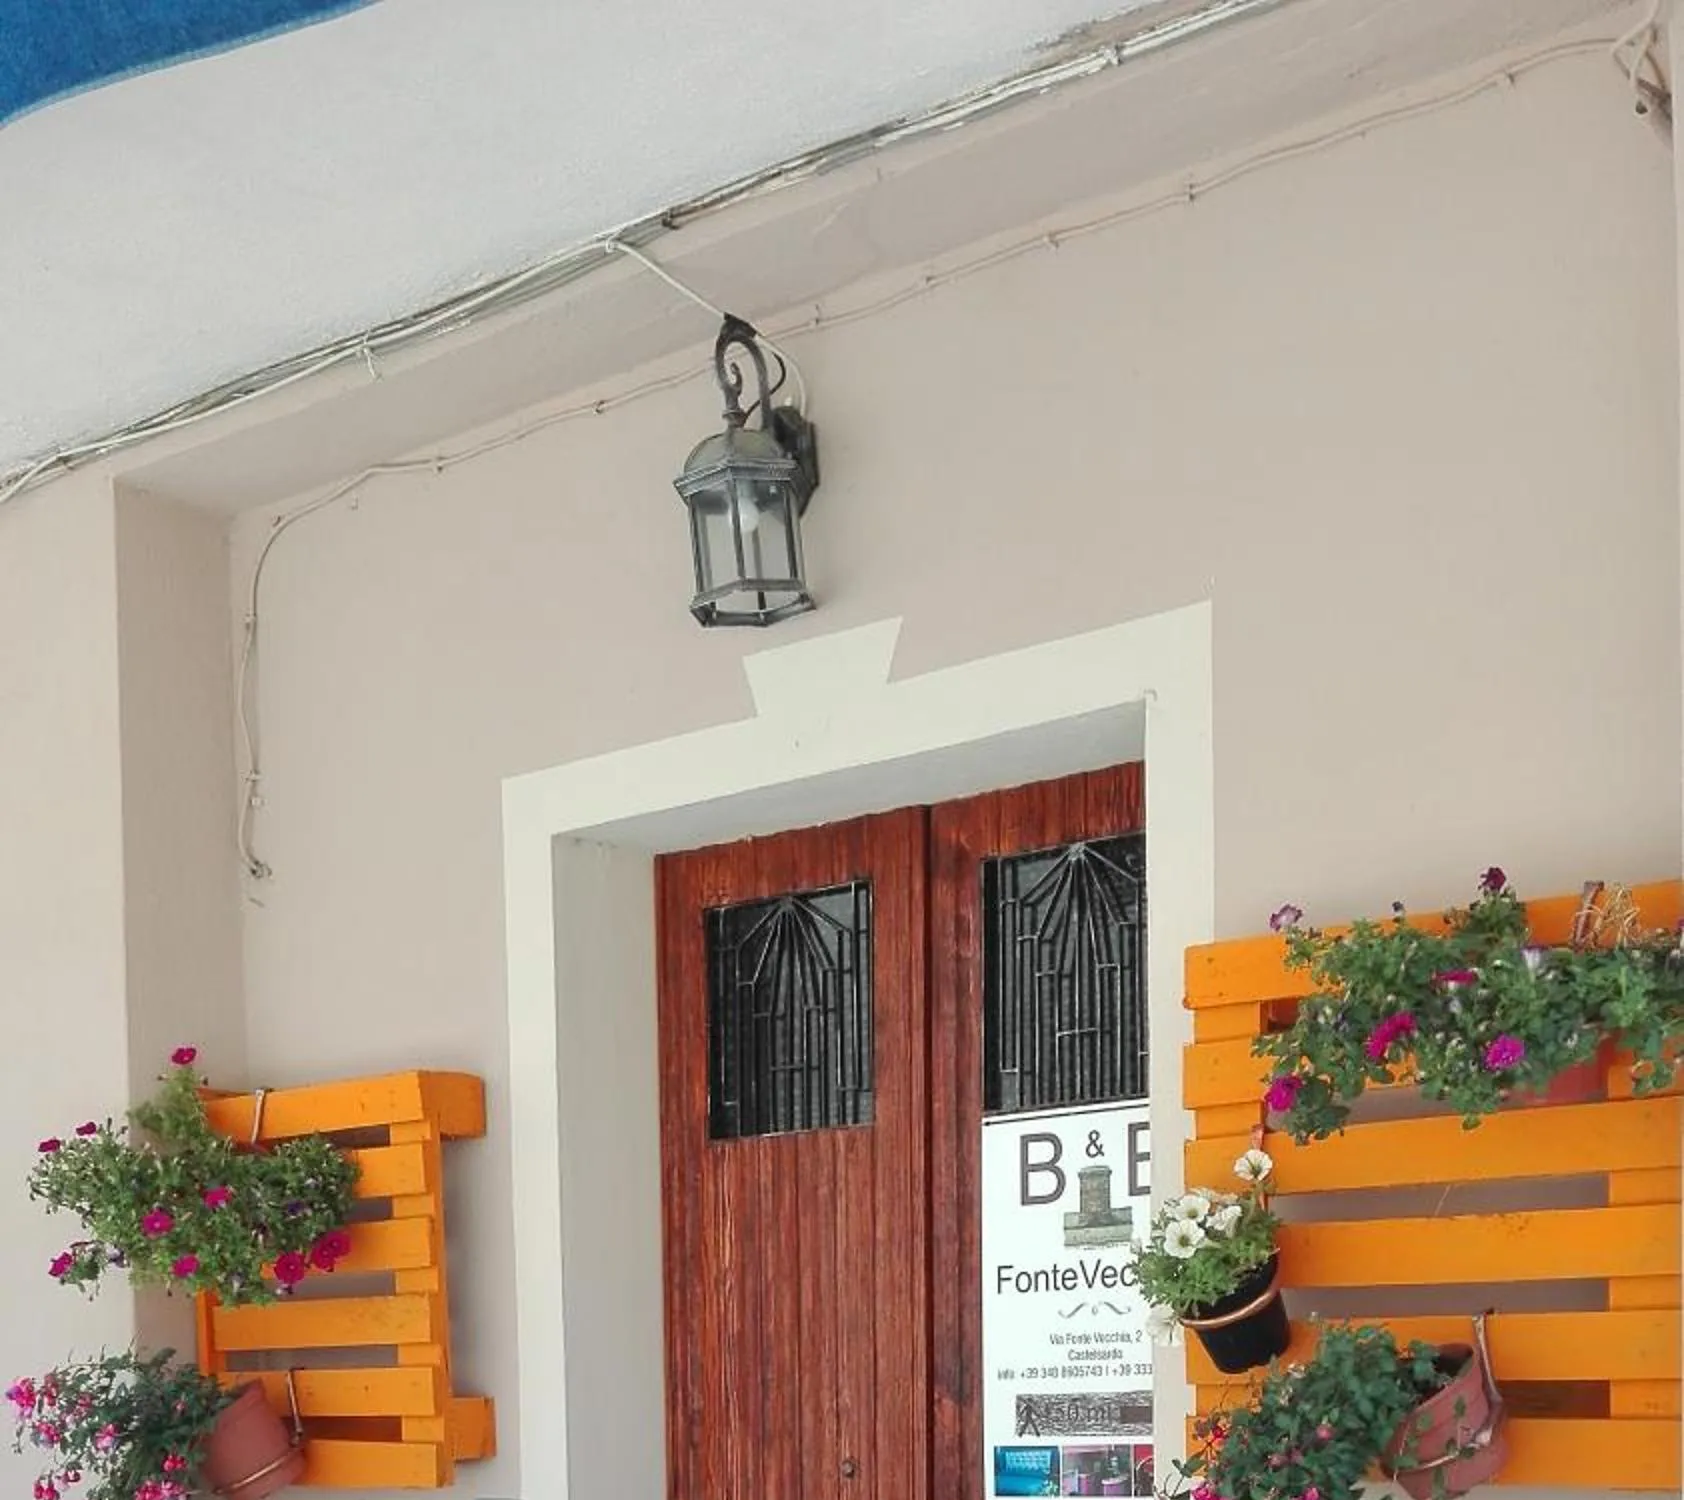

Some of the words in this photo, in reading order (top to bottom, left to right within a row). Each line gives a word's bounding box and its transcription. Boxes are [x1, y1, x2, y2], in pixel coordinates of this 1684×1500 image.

[1020, 1132, 1067, 1206] B
[1085, 1129, 1105, 1158] &
[997, 1258, 1139, 1295] FonteVec
[1049, 1333, 1064, 1345] Via
[1065, 1332, 1092, 1345] Fonte
[1135, 1329, 1143, 1343] 2
